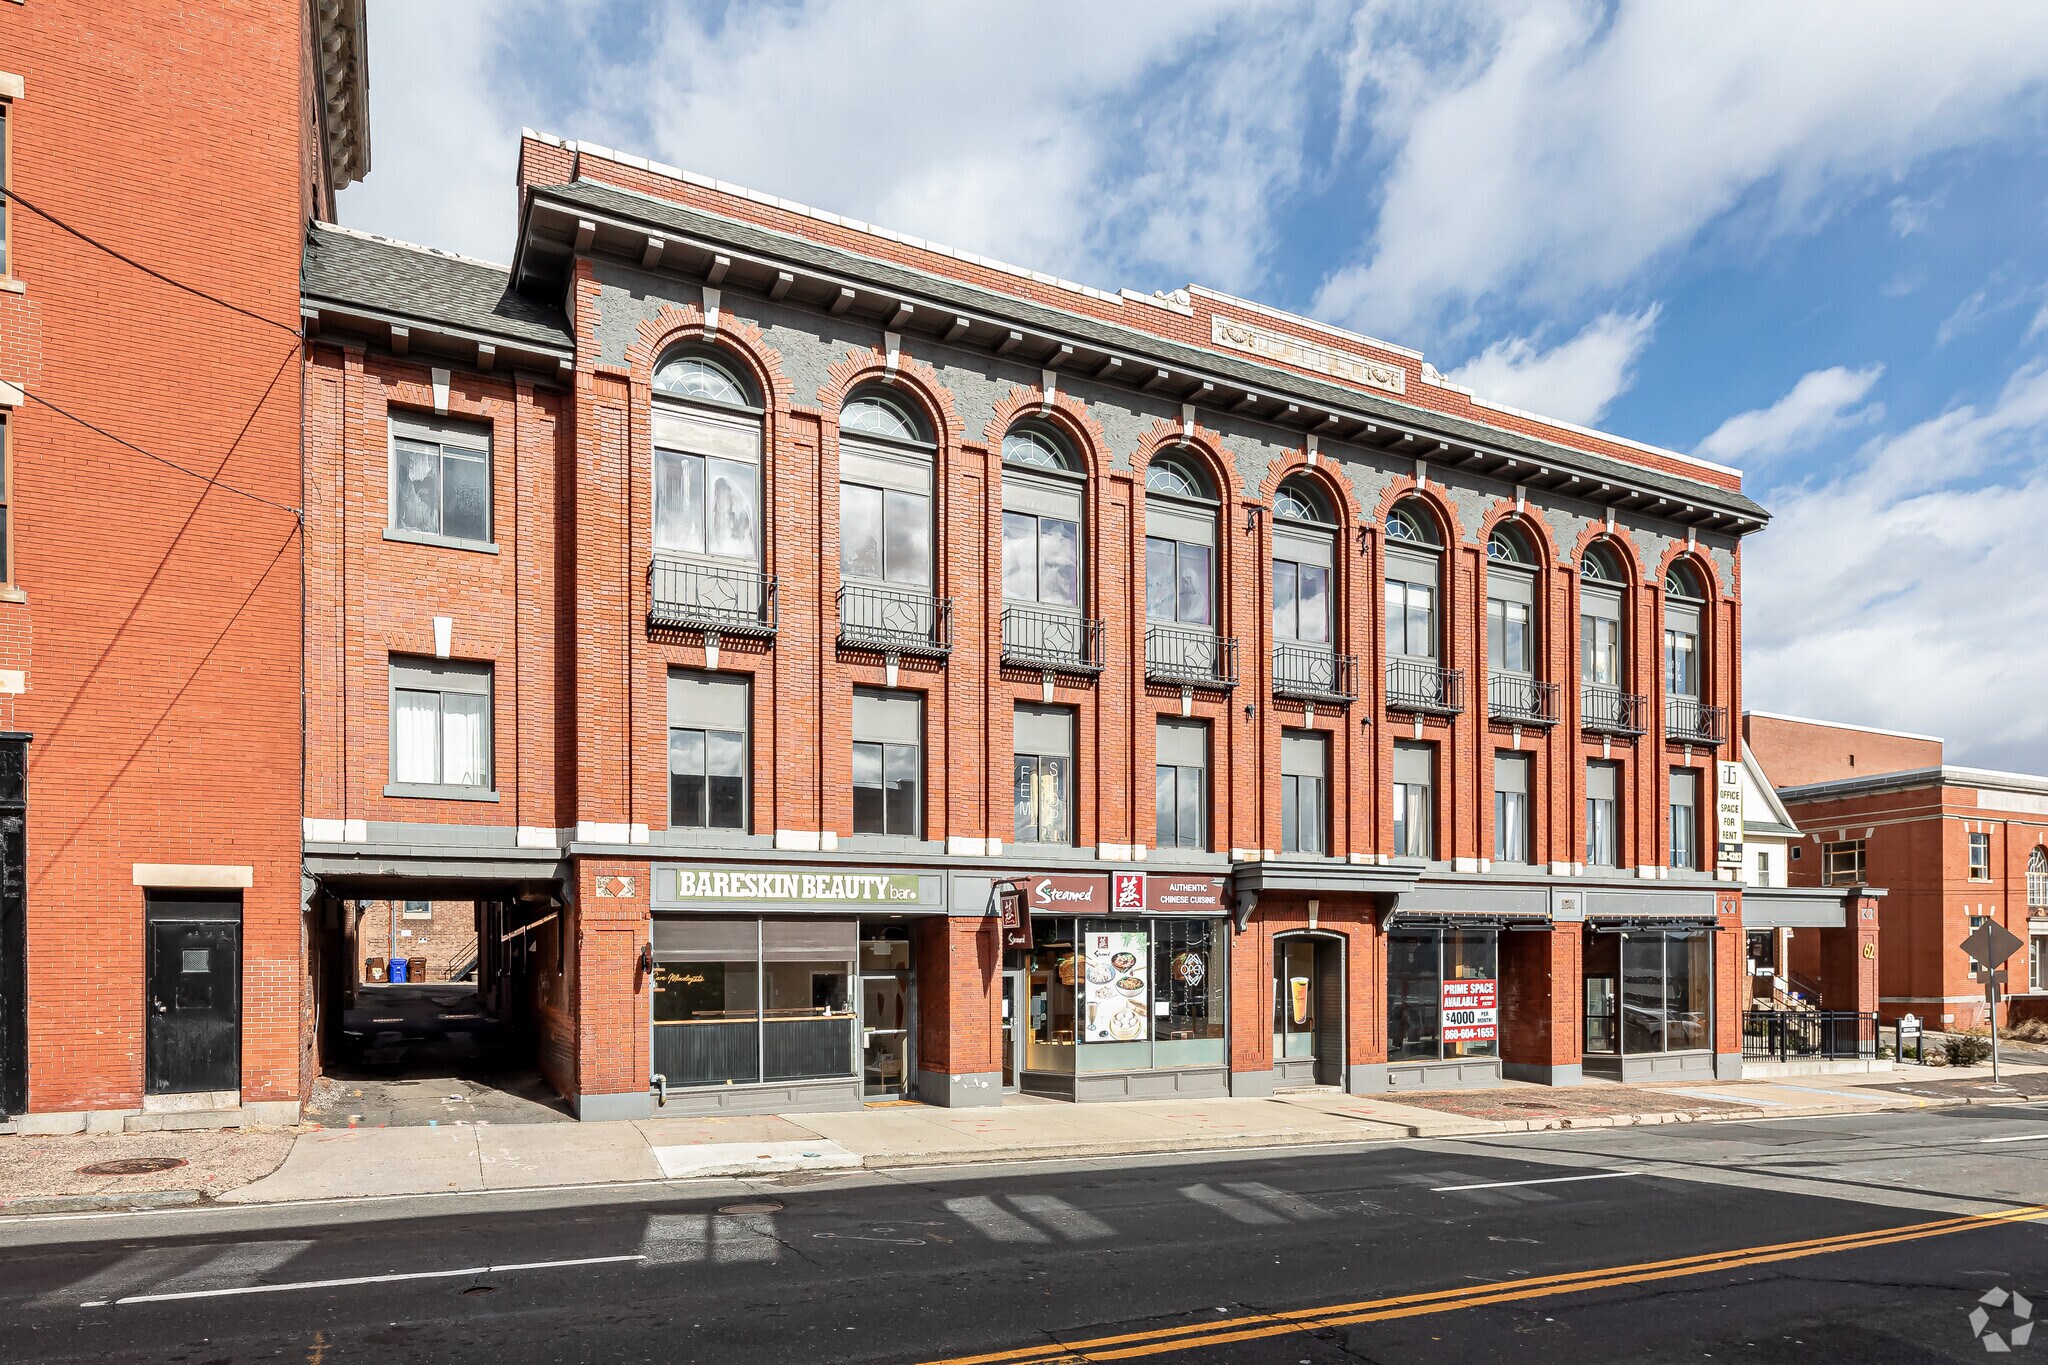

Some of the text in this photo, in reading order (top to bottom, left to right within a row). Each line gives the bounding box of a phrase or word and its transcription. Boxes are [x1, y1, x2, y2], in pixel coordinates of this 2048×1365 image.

[1720, 789, 1740, 800] OFFICE
[1720, 803, 1739, 813] SPACE
[1723, 817, 1736, 827] FOR
[1722, 831, 1738, 840] RENT
[679, 871, 800, 899] BARESKIN
[801, 874, 890, 900] BEAUTY
[1035, 878, 1094, 904] Steamed
[1119, 876, 1140, 907] 蒸
[1169, 883, 1208, 893] AUTHENTIC
[1160, 895, 1216, 905] CHINESE CUISINE
[1863, 942, 1875, 959] 62
[1180, 964, 1205, 976] OPEN
[1444, 982, 1494, 994] PRIME SPACE
[1444, 996, 1479, 1008] AVAILABLE
[1446, 1011, 1474, 1024] $4000
[1445, 1028, 1494, 1039] 860-604-1655
